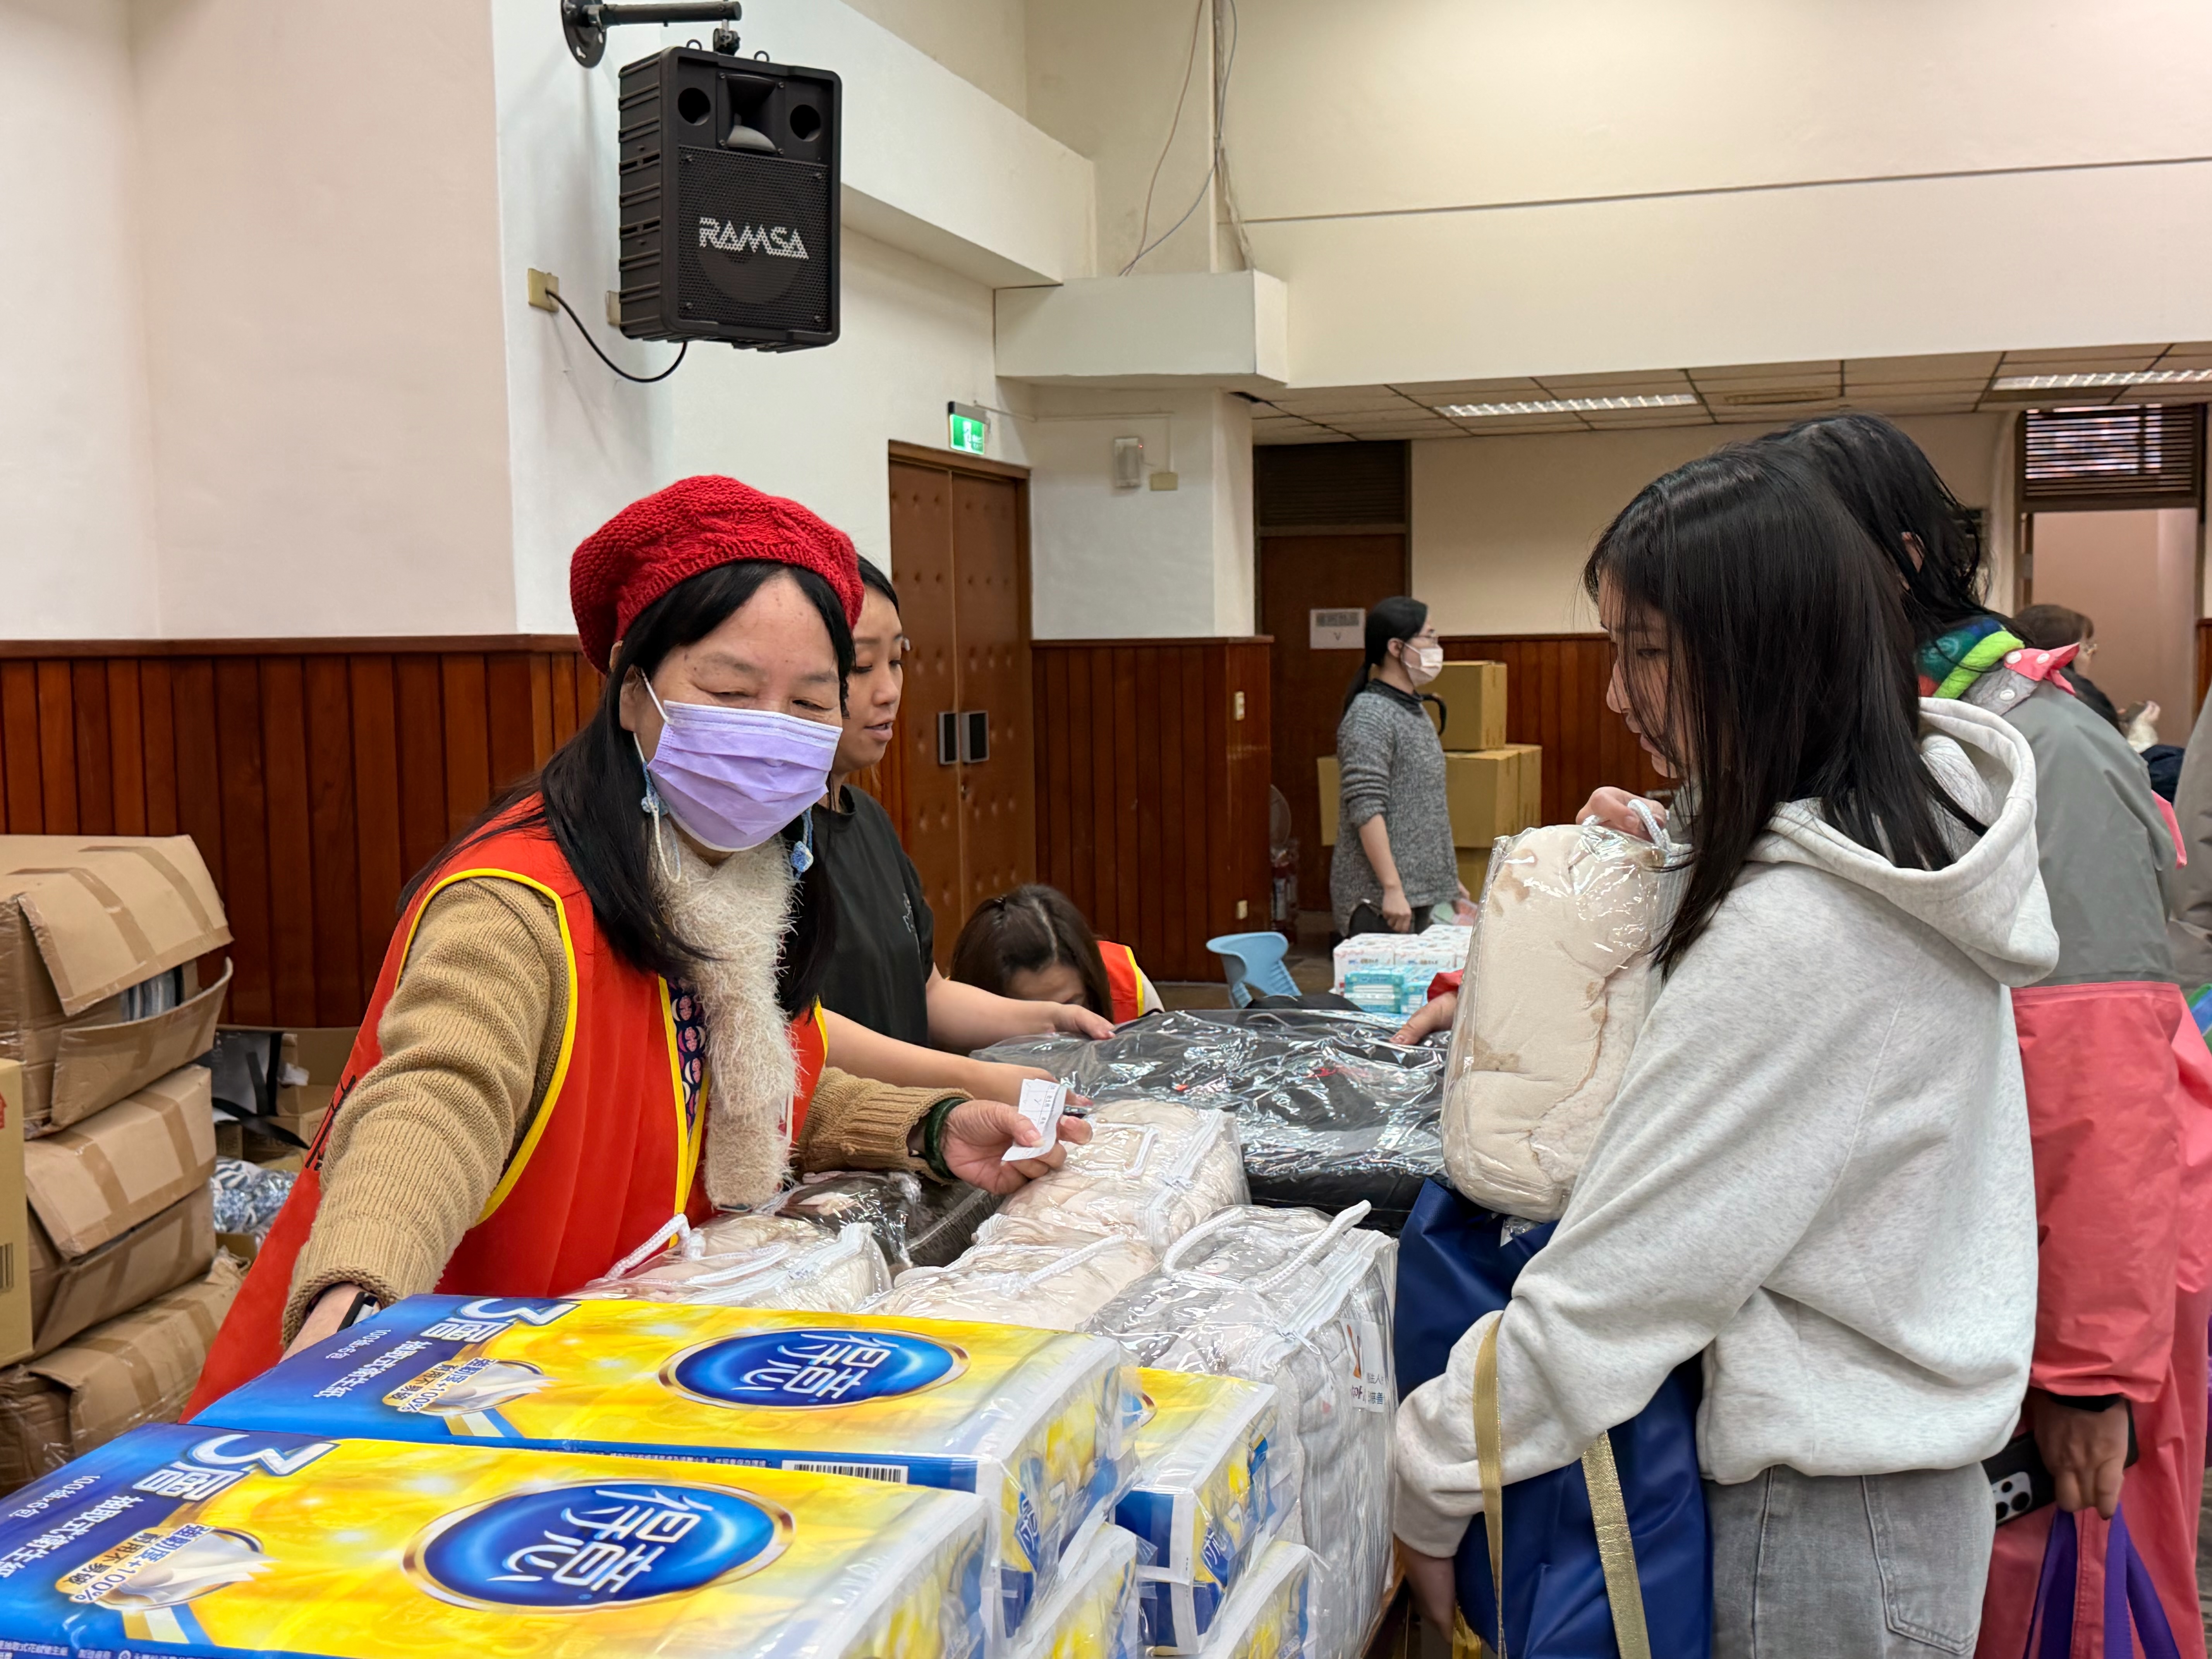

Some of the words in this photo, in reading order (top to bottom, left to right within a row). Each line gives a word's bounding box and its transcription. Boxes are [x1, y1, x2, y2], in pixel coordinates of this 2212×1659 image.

[699, 217, 809, 259] RAMSA
[313, 1340, 432, 1398] 抽取式衛生紙
[68, 1531, 163, 1585] 耐用不易破
